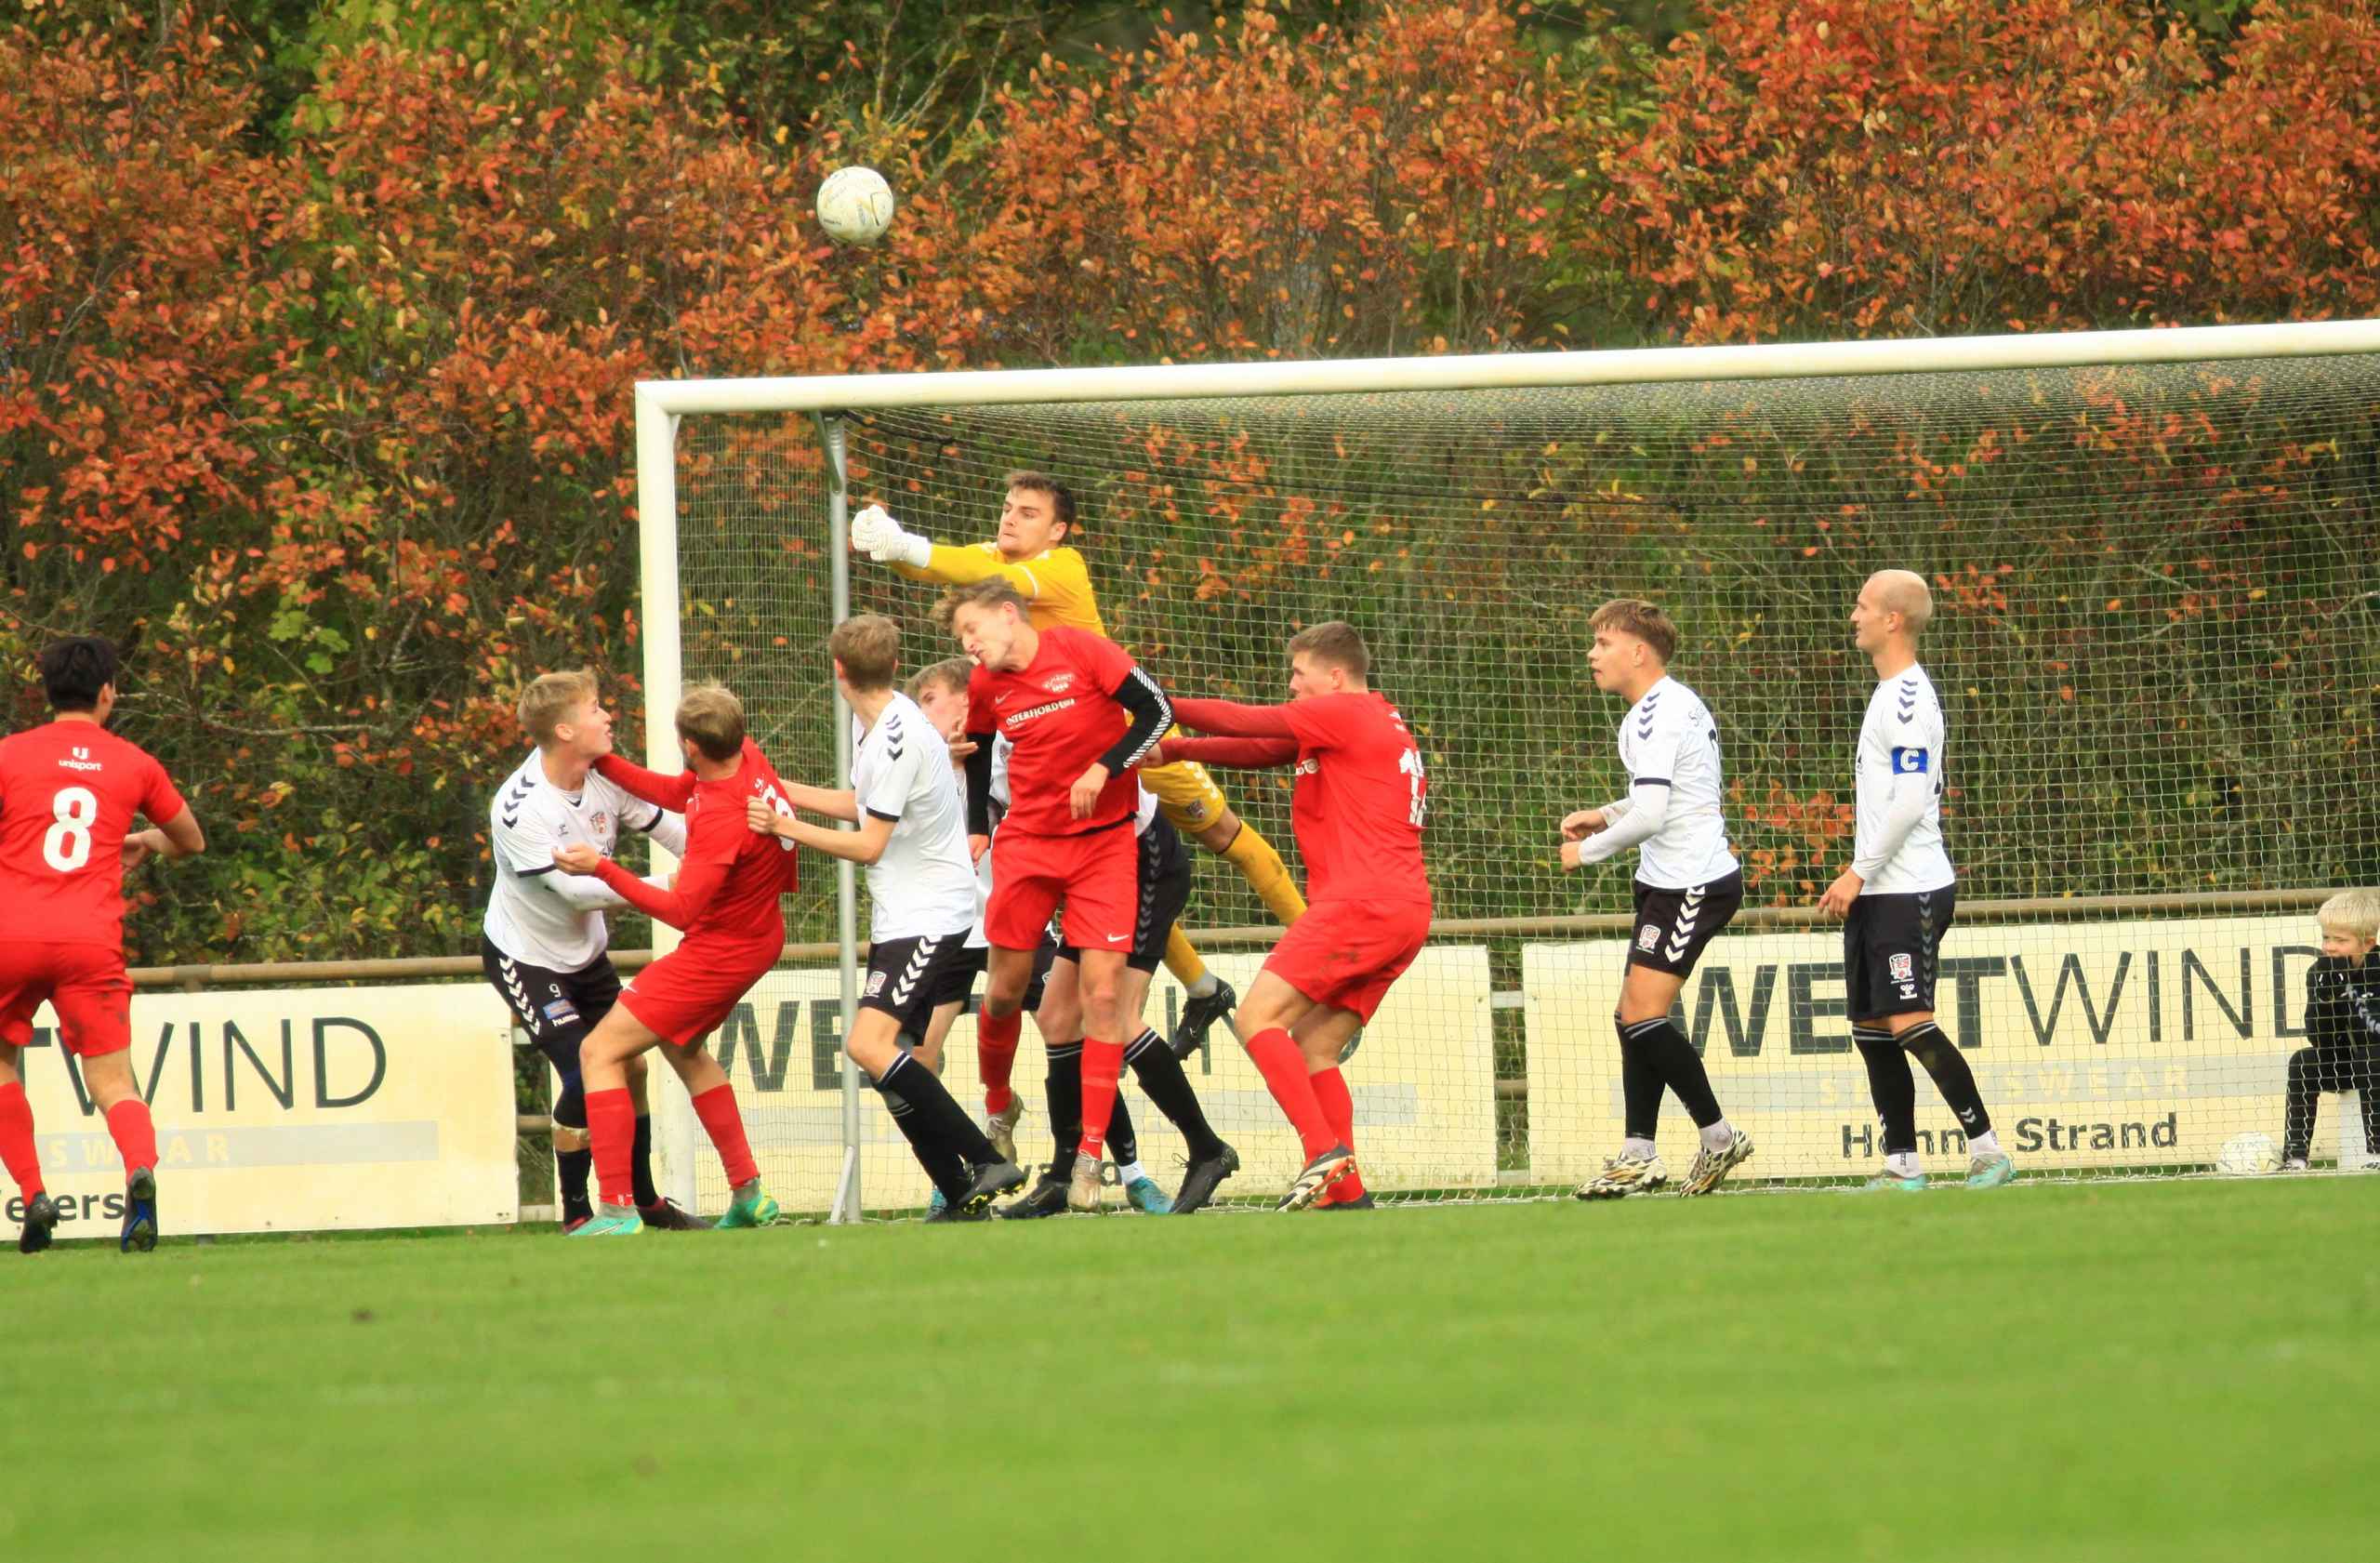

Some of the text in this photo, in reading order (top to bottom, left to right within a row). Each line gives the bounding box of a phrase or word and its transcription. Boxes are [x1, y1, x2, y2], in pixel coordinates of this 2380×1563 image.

[1900, 748, 1920, 772] C
[43, 787, 98, 872] 8
[549, 983, 562, 998] 9
[1671, 946, 2322, 1057] WETWIND
[2016, 1112, 2178, 1152] Strand
